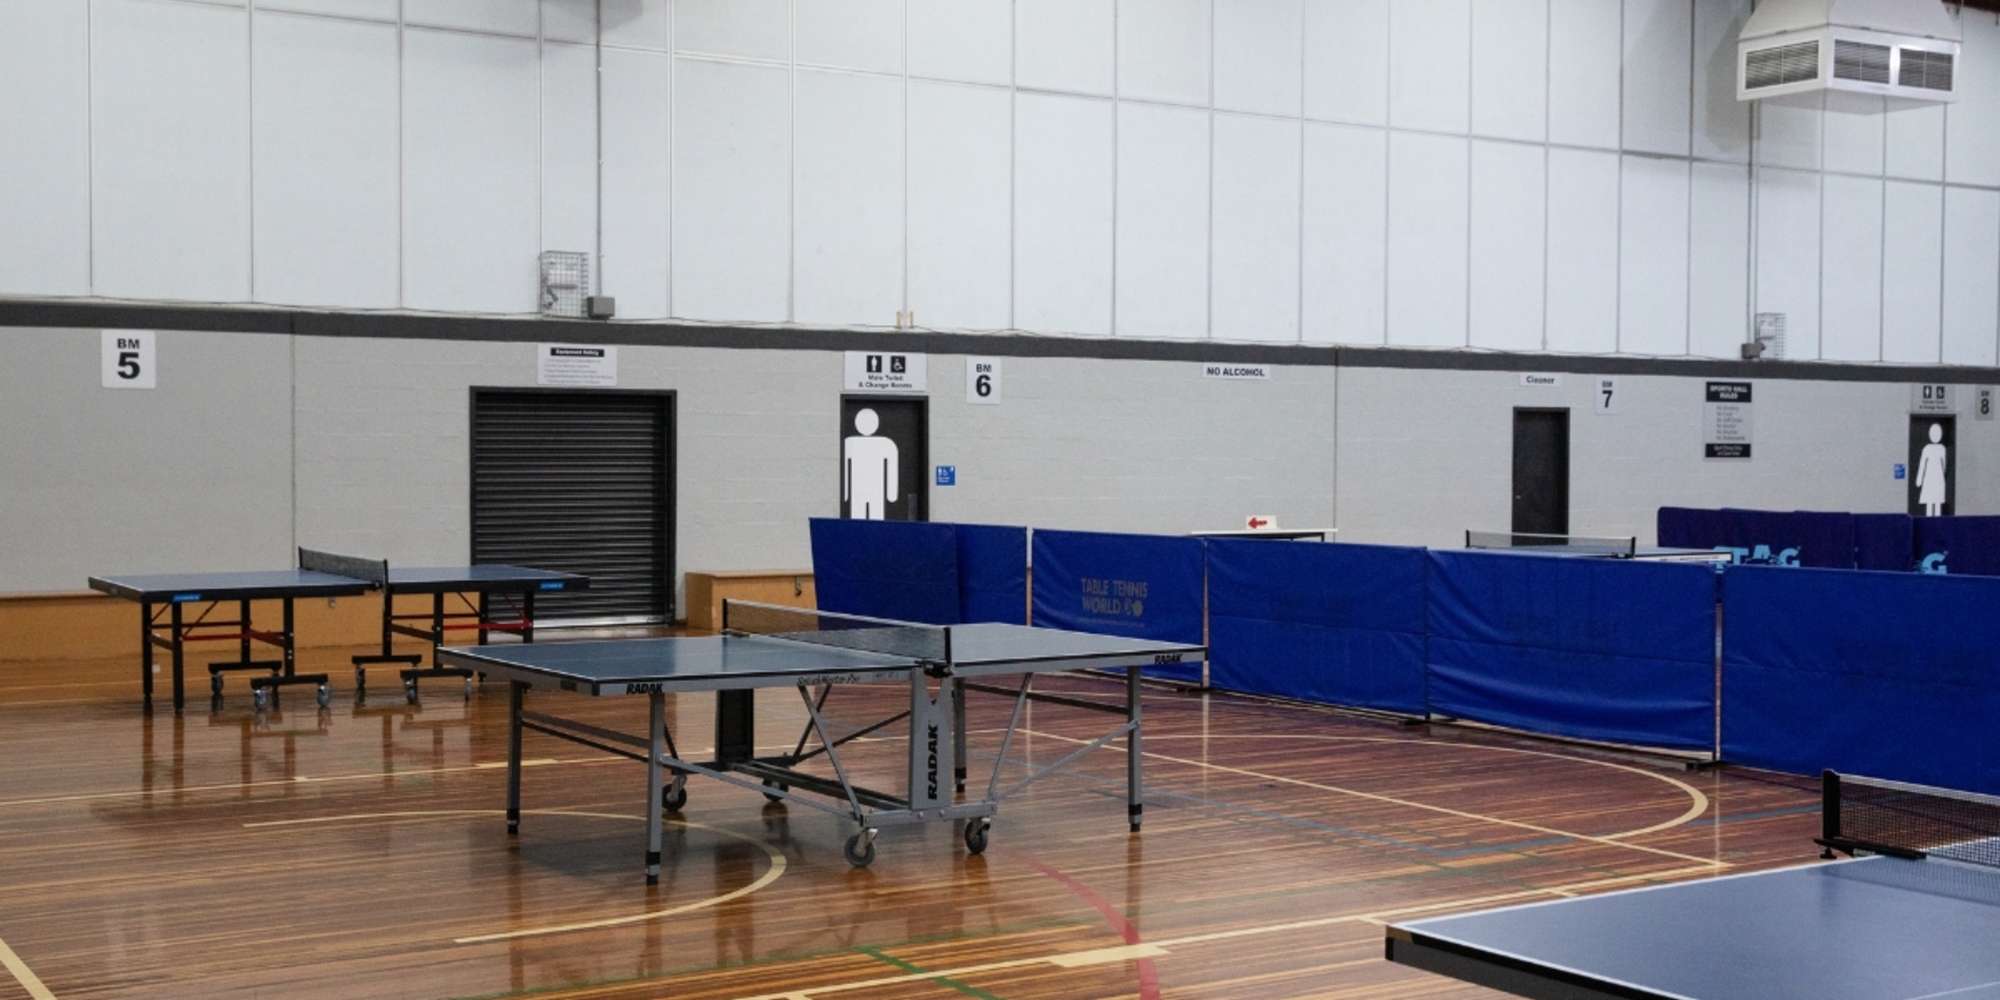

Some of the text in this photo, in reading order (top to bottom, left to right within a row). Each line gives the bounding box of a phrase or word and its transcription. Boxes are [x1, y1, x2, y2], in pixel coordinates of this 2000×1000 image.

[117, 338, 140, 349] BM
[117, 352, 141, 380] 5
[976, 363, 992, 373] BM
[1206, 366, 1266, 377] NO ALCOHOL
[976, 374, 992, 397] 6
[1526, 375, 1555, 384] Cleaner
[1602, 390, 1613, 408] 7
[1981, 398, 1990, 414] 8
[1081, 578, 1148, 598] TABLE TENNIS
[1082, 596, 1121, 615] WORLD
[1154, 653, 1183, 664] RADAK
[627, 683, 663, 694] RADAK
[928, 723, 938, 800] RADAK
